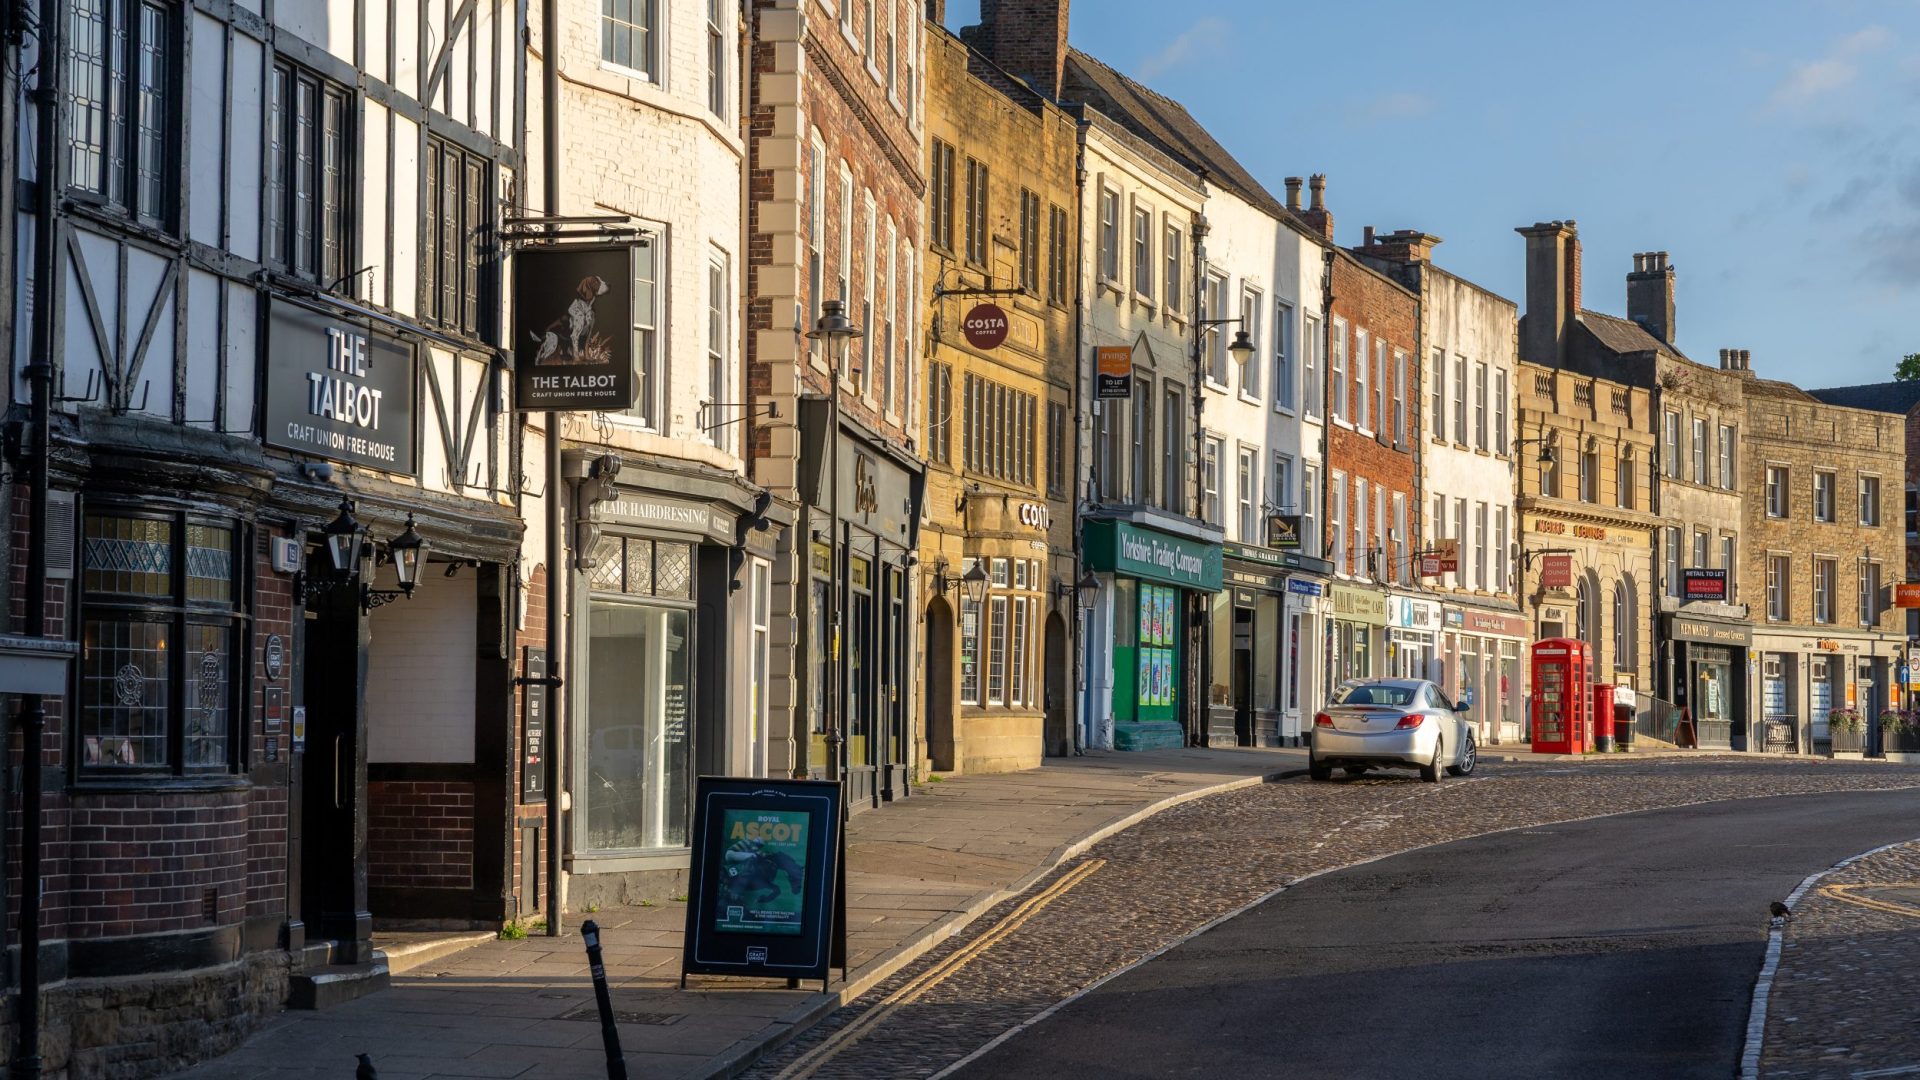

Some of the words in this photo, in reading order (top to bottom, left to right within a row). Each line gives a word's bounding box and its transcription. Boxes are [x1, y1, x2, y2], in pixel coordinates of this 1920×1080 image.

[967, 318, 1005, 329] COSTA
[327, 327, 366, 378] THE
[531, 376, 560, 389] THE
[562, 374, 617, 389] TALBOT
[308, 371, 382, 430] TALBOT
[287, 421, 314, 445] CRAFT
[316, 428, 344, 451] UNION
[346, 435, 366, 456] FREE
[368, 441, 395, 462] HOUSE
[629, 502, 706, 525] HAIRDRESSING
[1121, 532, 1152, 564] Yorkshire
[1152, 540, 1175, 576] Trading
[1175, 545, 1203, 582] Company
[757, 815, 780, 823] ROYAL
[730, 821, 803, 843] ASCOT
[728, 866, 738, 877] 6
